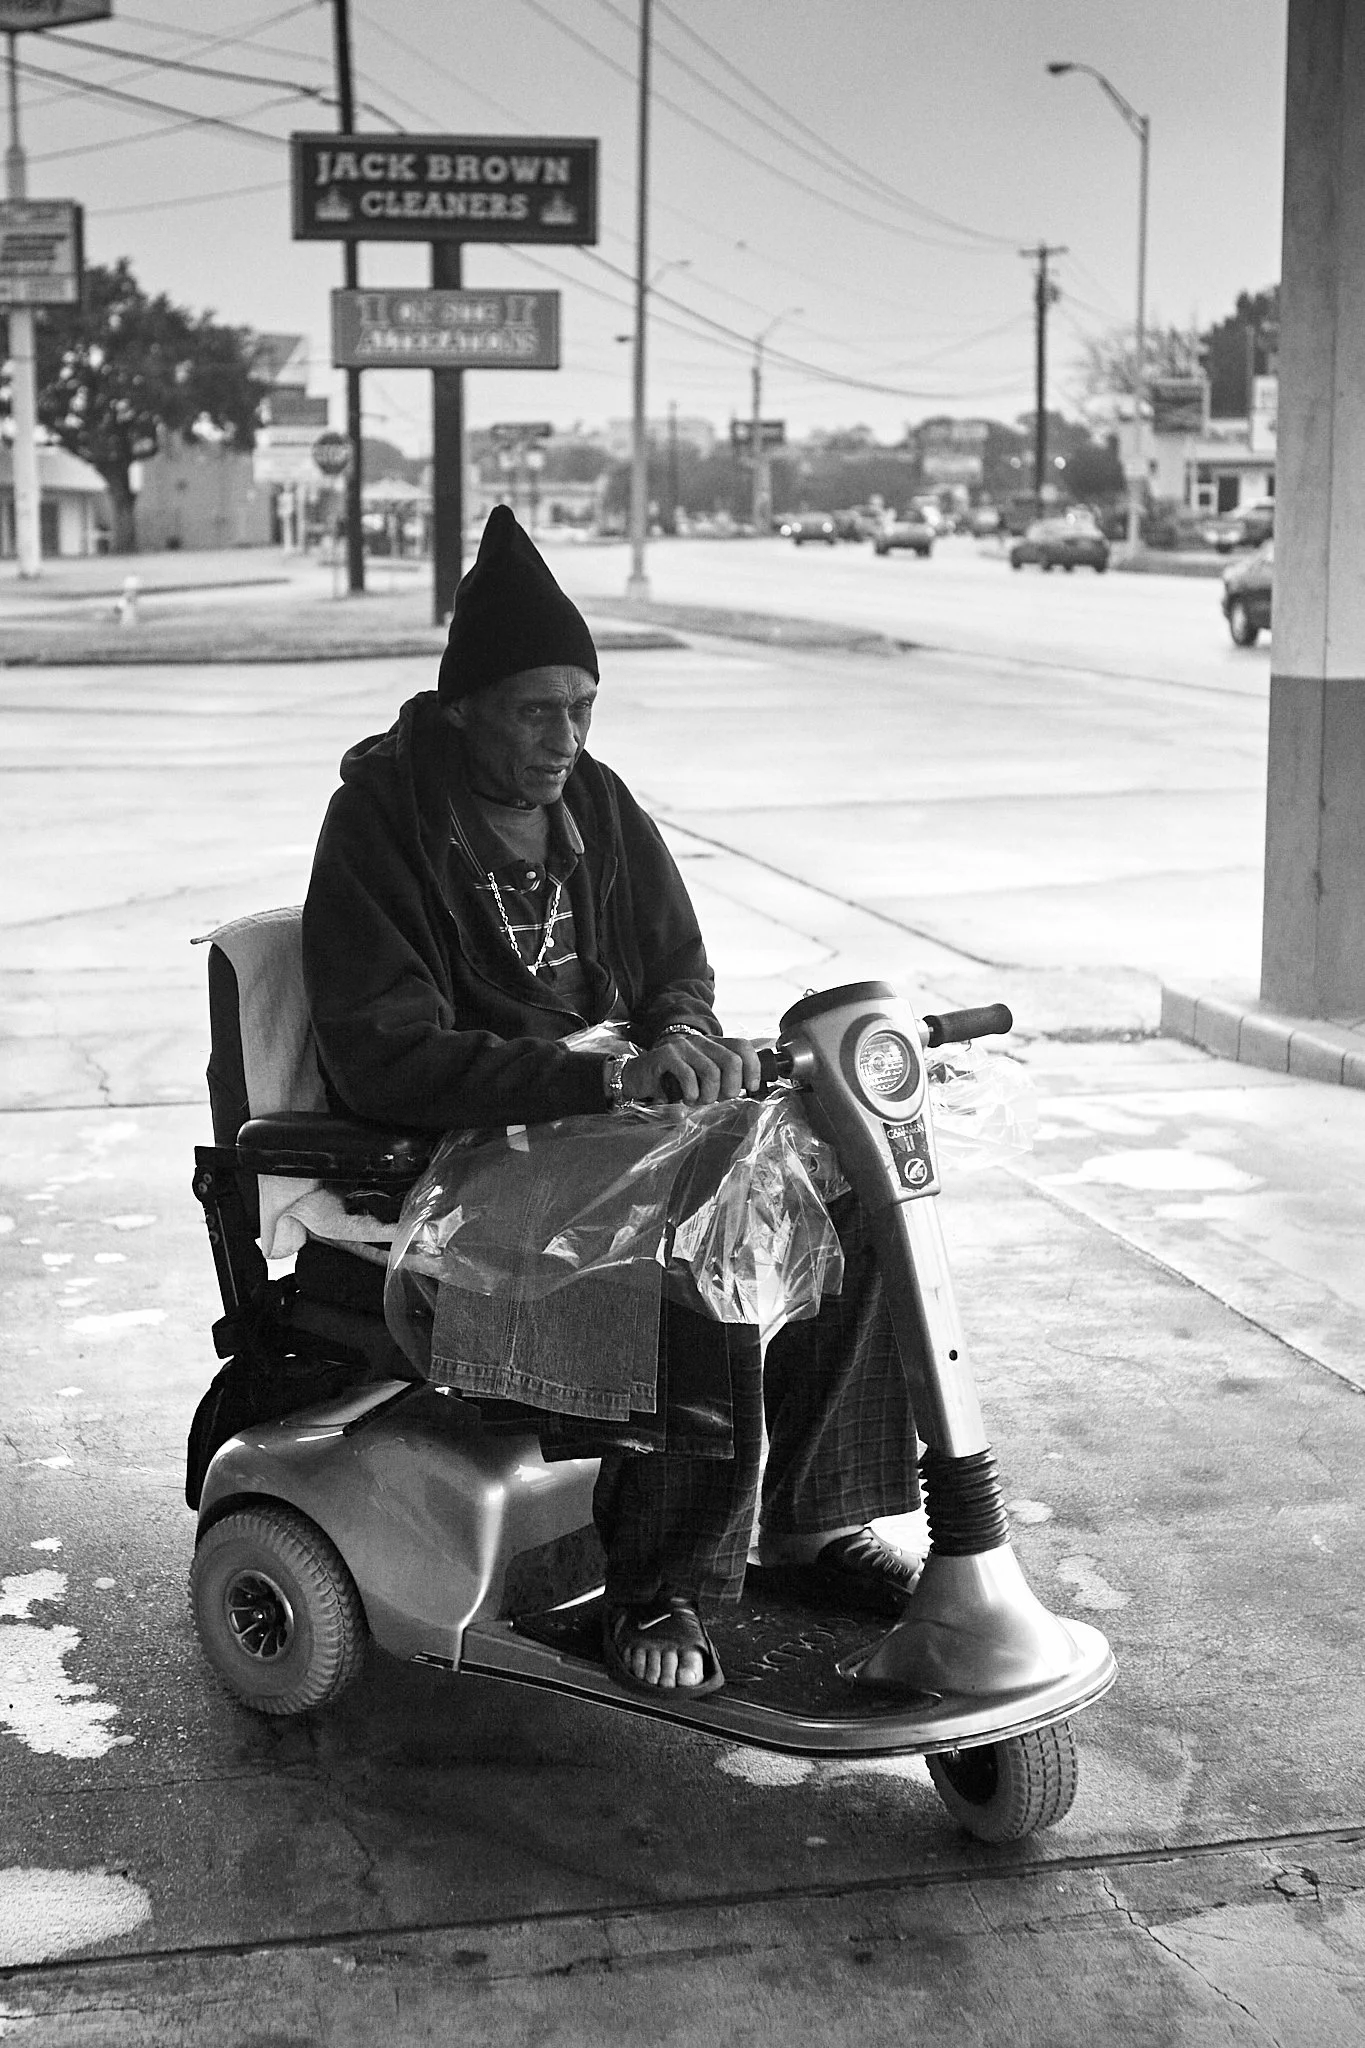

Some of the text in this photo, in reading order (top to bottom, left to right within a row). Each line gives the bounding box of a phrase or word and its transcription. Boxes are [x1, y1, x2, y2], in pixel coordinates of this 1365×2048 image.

[315, 152, 571, 186] JACK BROWN
[360, 191, 529, 220] CLEANERS
